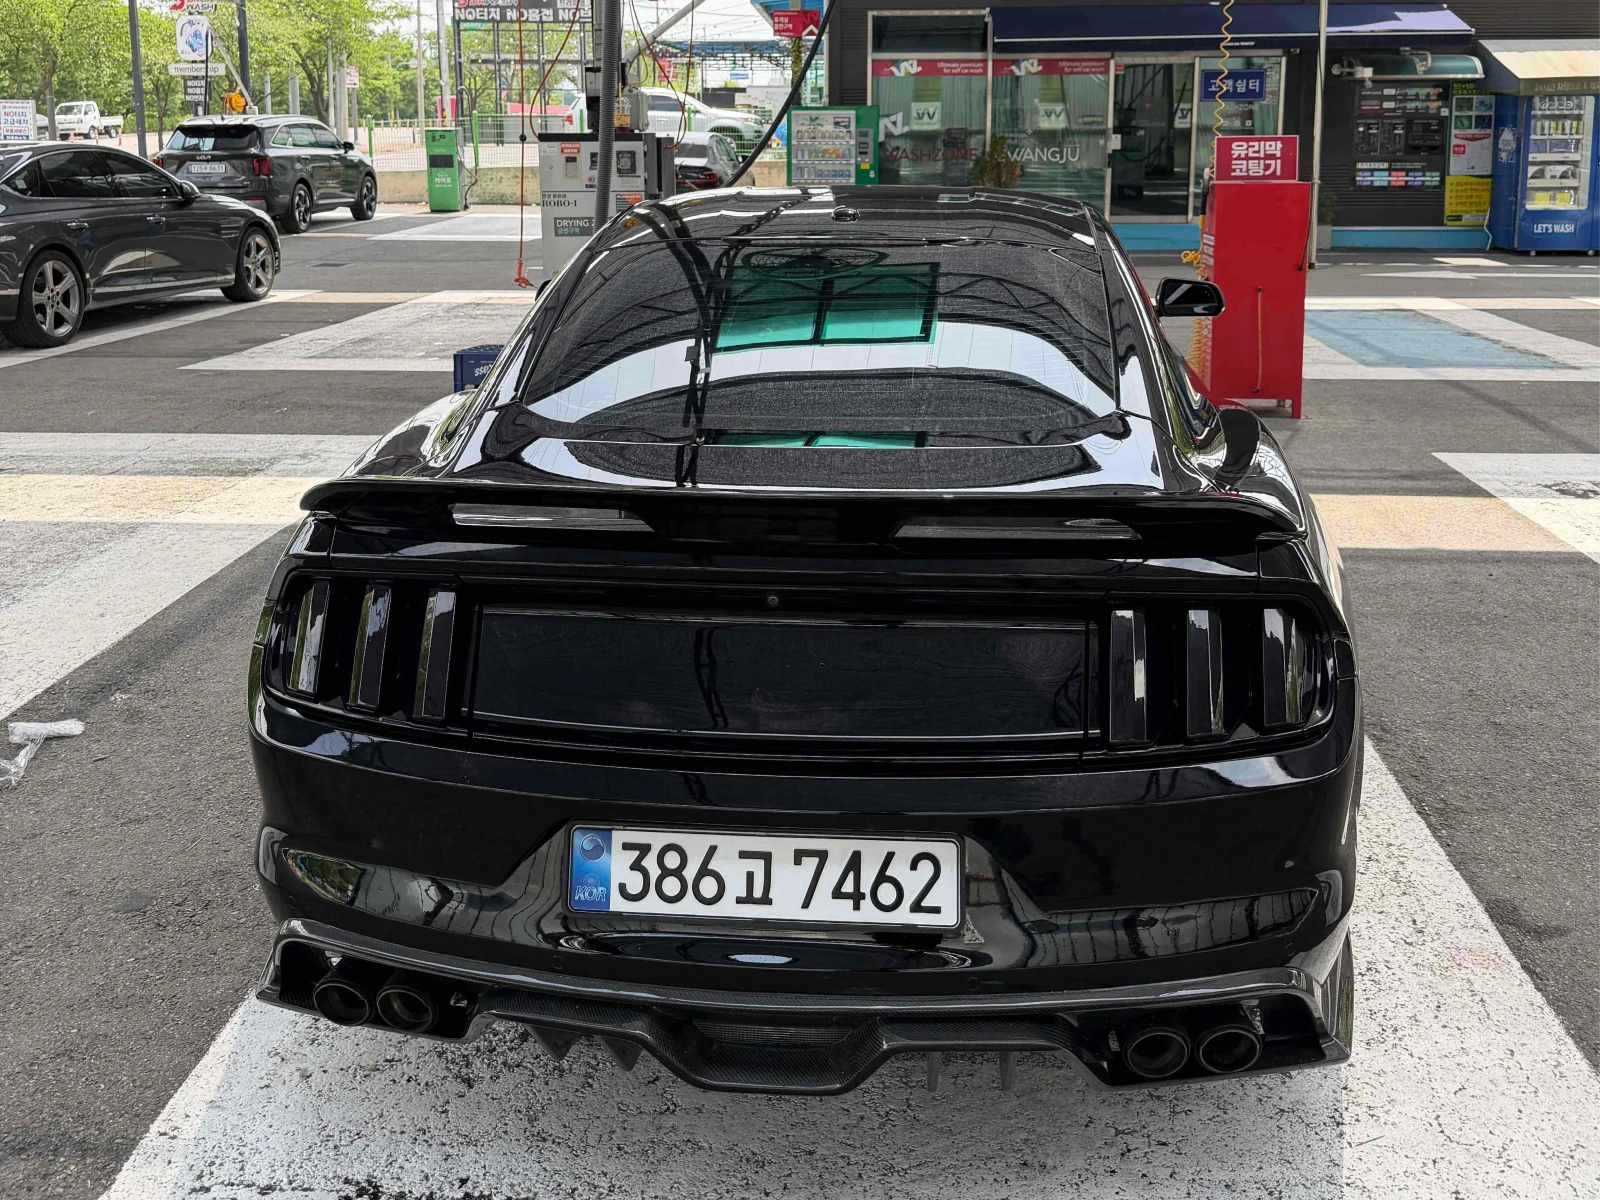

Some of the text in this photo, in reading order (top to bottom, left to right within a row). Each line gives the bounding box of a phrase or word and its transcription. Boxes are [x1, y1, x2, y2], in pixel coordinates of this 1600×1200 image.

[454, 8, 500, 20] NO터치
[558, 8, 592, 21] NO브
[174, 65, 219, 74] memberip
[1208, 79, 1260, 93] 고객쉼터
[1005, 147, 1080, 164] WANGJU
[1231, 141, 1283, 158] 유리막
[1231, 160, 1281, 176] 코팅기
[556, 219, 589, 227] DRYING
[1533, 224, 1574, 233] LET'S WASH
[618, 842, 943, 916] 386고 7462
[574, 885, 607, 902] KOR
